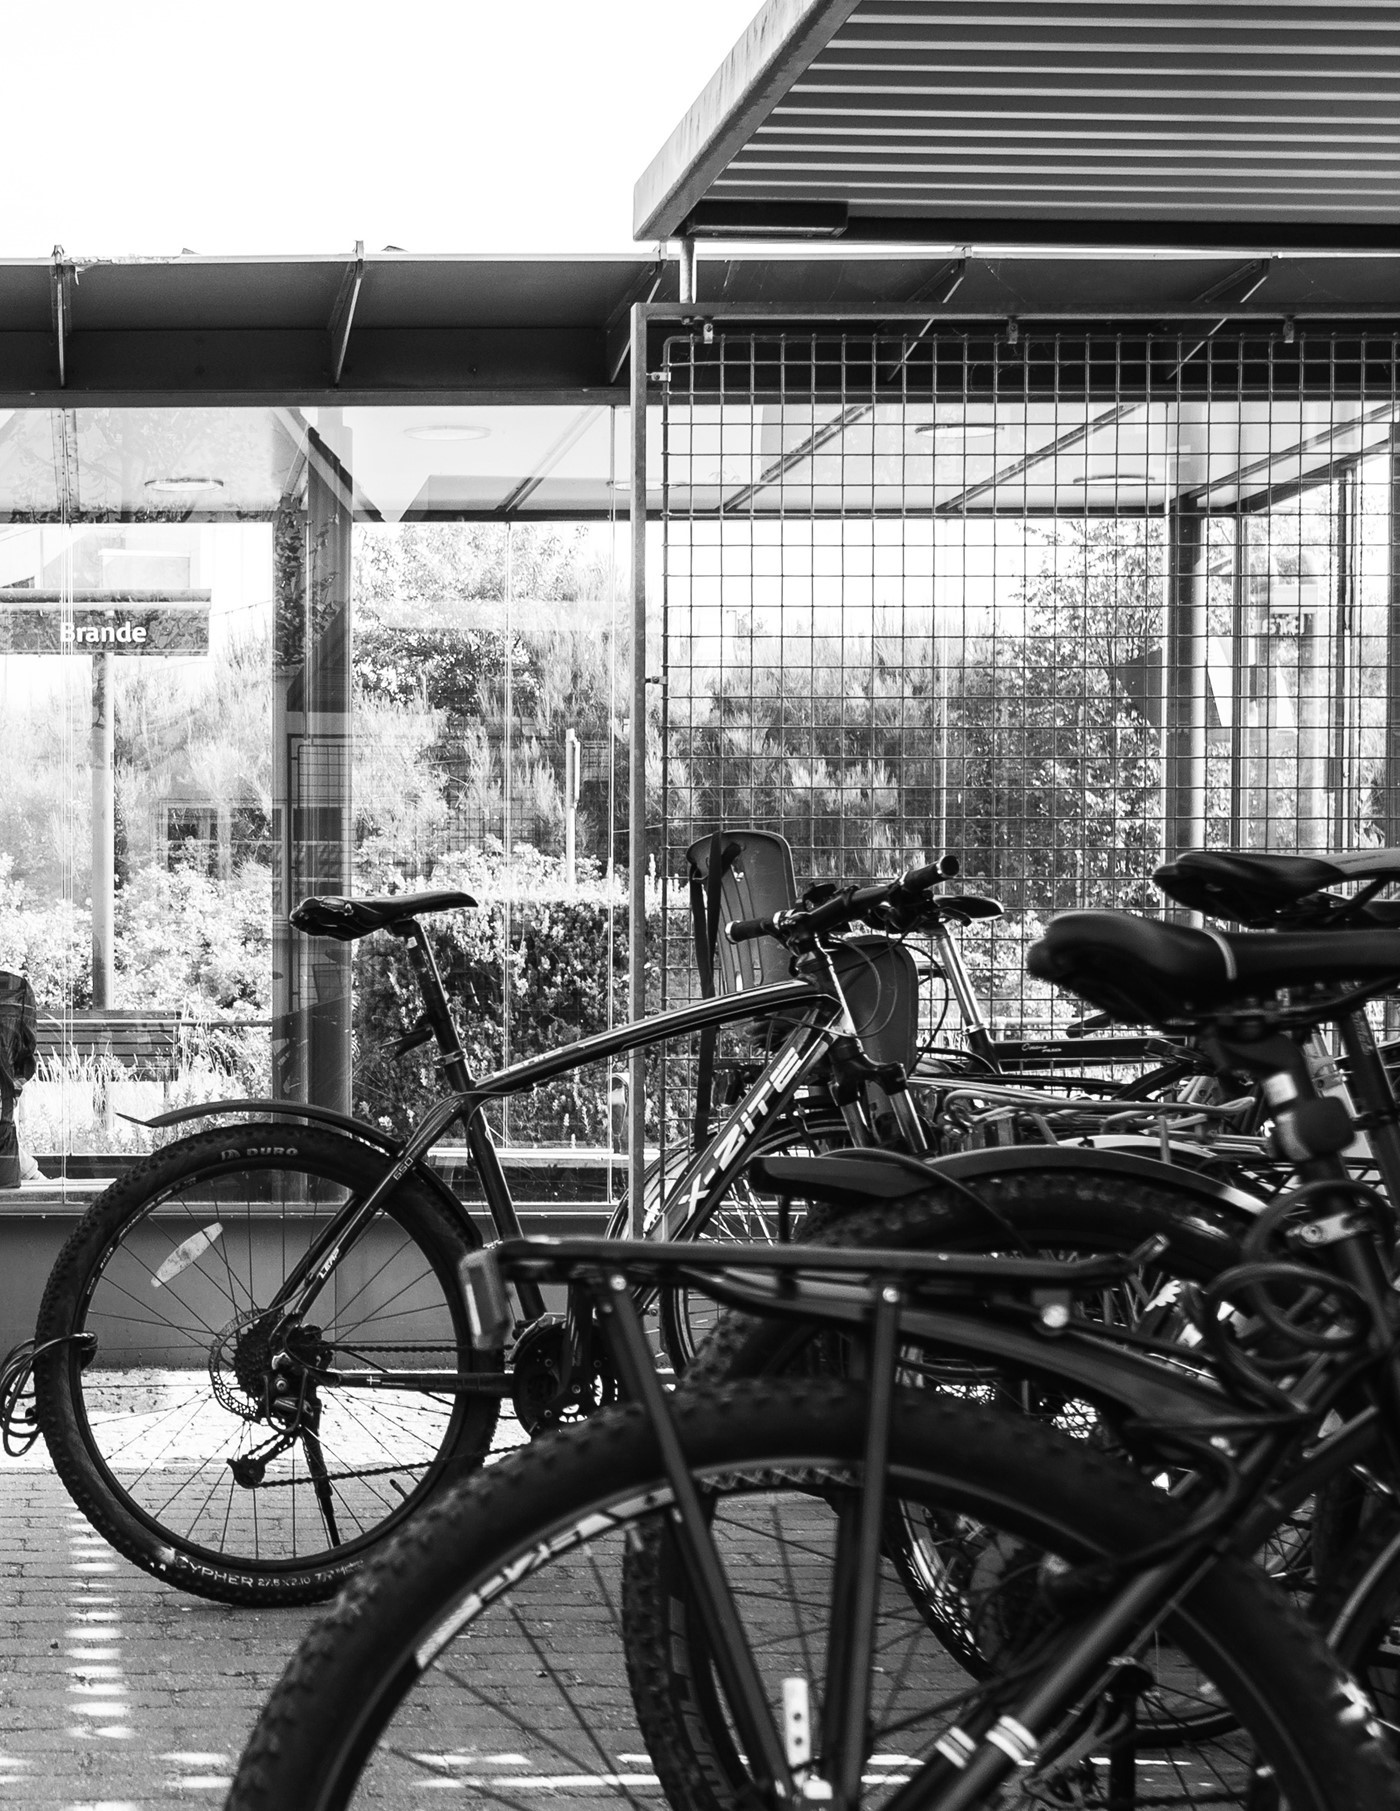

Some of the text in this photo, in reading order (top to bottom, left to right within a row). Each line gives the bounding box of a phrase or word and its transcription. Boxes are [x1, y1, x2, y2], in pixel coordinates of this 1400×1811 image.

[60, 621, 147, 643] Brande
[246, 1146, 299, 1156] DURO
[393, 1156, 414, 1181] 650
[175, 1554, 254, 1588] CYPHER
